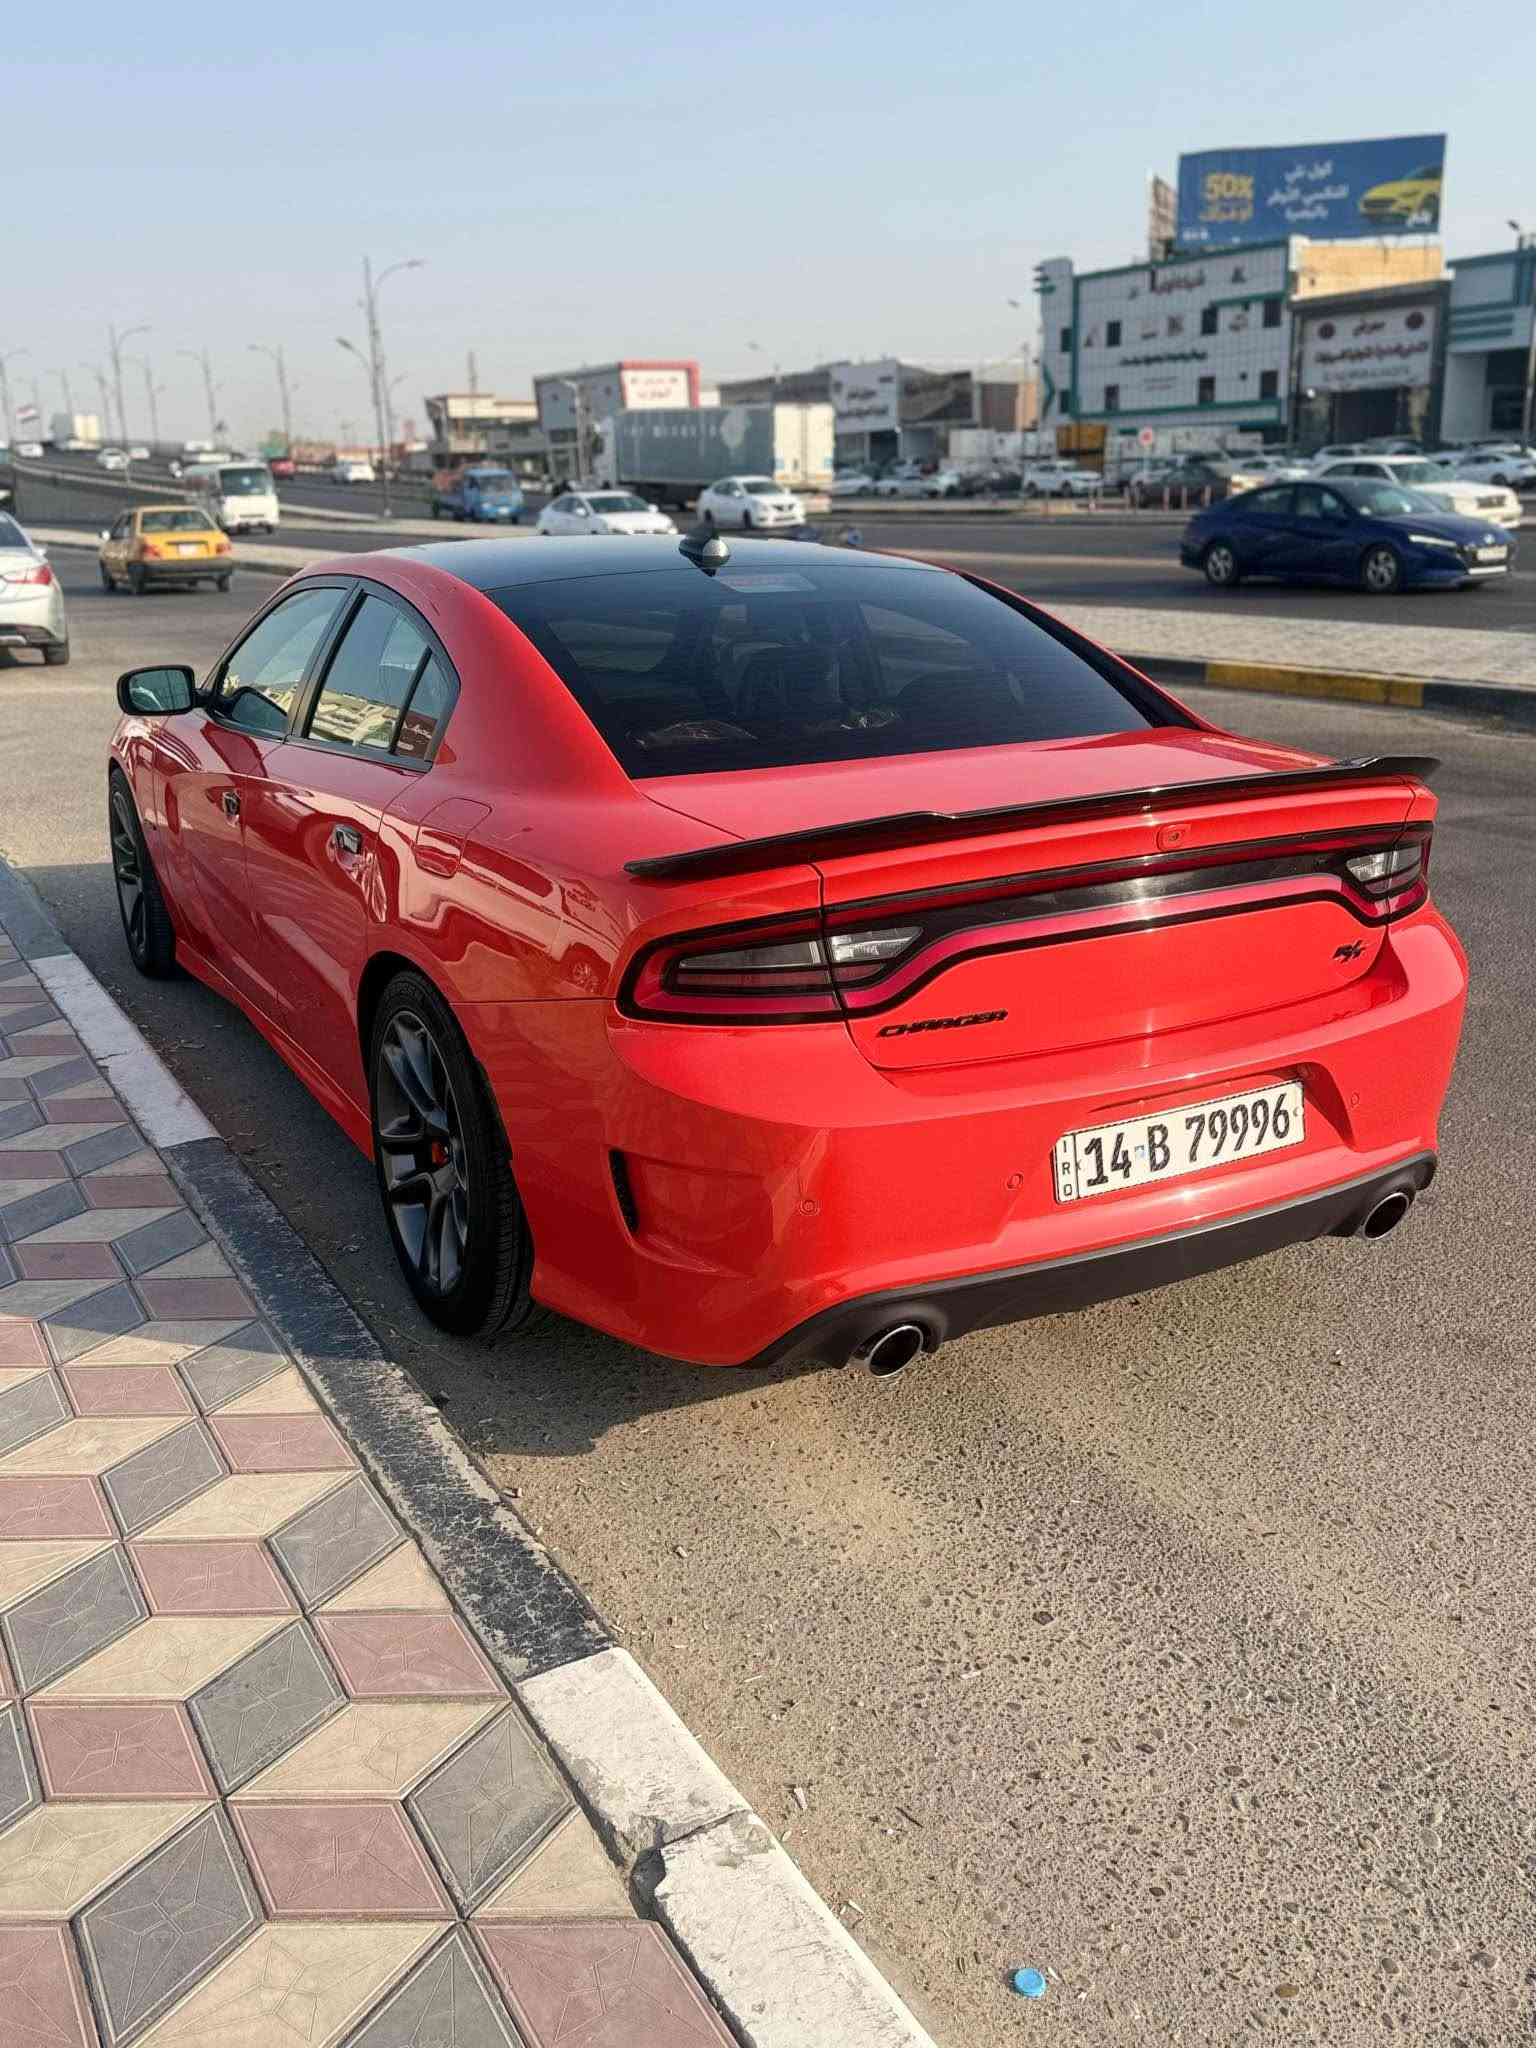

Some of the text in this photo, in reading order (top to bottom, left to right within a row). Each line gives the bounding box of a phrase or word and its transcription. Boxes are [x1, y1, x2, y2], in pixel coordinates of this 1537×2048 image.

[1206, 172, 1254, 200] 50%
[877, 1010, 1008, 1038] CHARGER
[1084, 1092, 1290, 1187] 14 B 79996
